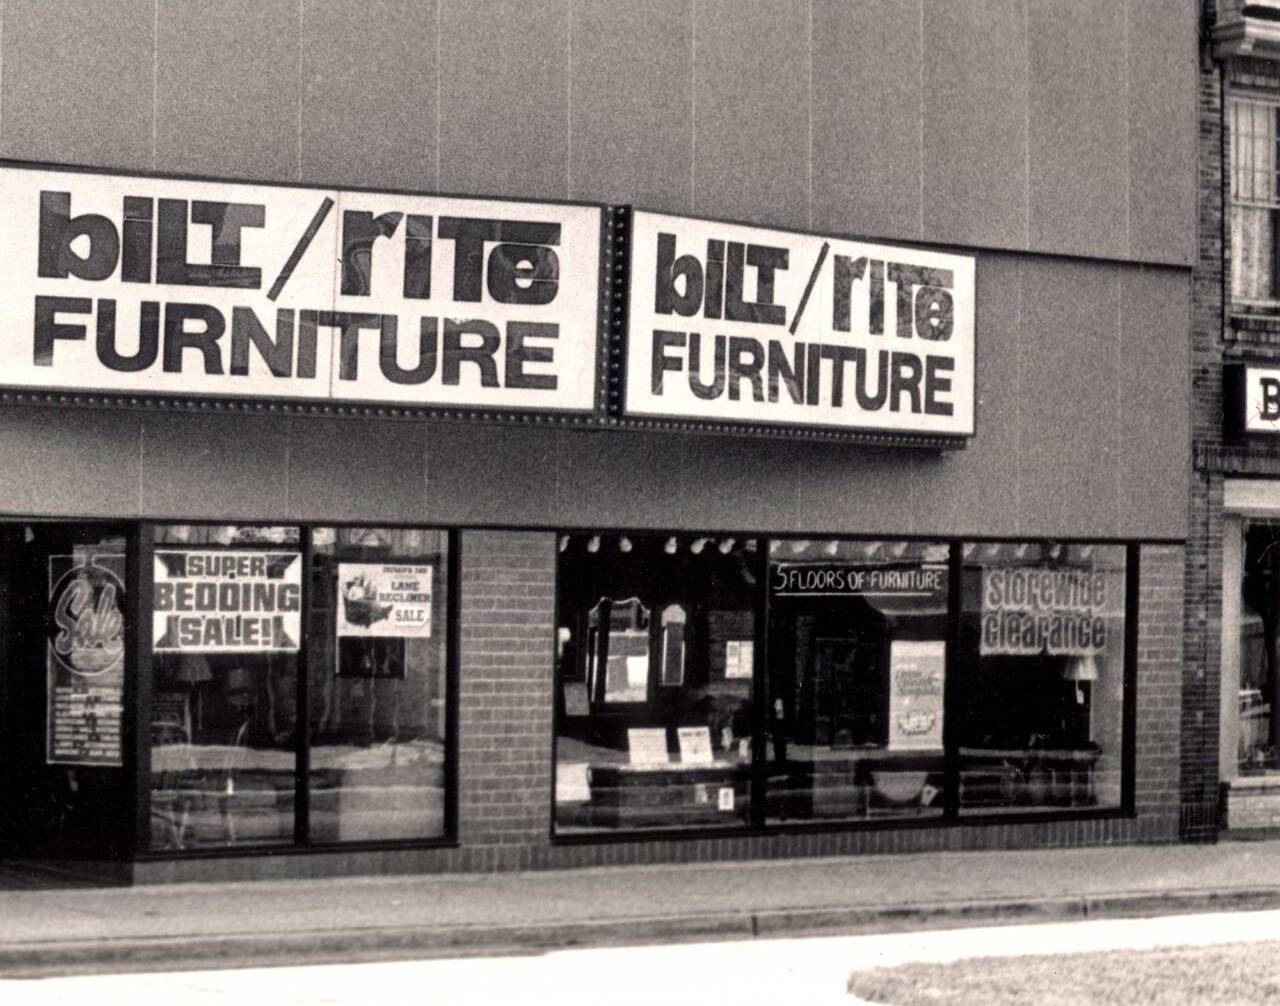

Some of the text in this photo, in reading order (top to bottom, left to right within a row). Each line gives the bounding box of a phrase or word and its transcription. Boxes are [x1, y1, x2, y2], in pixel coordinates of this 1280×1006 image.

[32, 294, 561, 392] FURNITURE
[650, 329, 956, 417] FURNITURE
[186, 554, 267, 578] SUPER
[773, 563, 943, 590] 5 FLOORS OF FURNITURE
[153, 581, 301, 612] BEDDING
[379, 592, 431, 603] RECLINER
[391, 581, 421, 591] LANE
[54, 578, 123, 655] Sale
[395, 609, 425, 622] SALE
[179, 616, 272, 647] SALE!
[983, 614, 1106, 649] clearance
